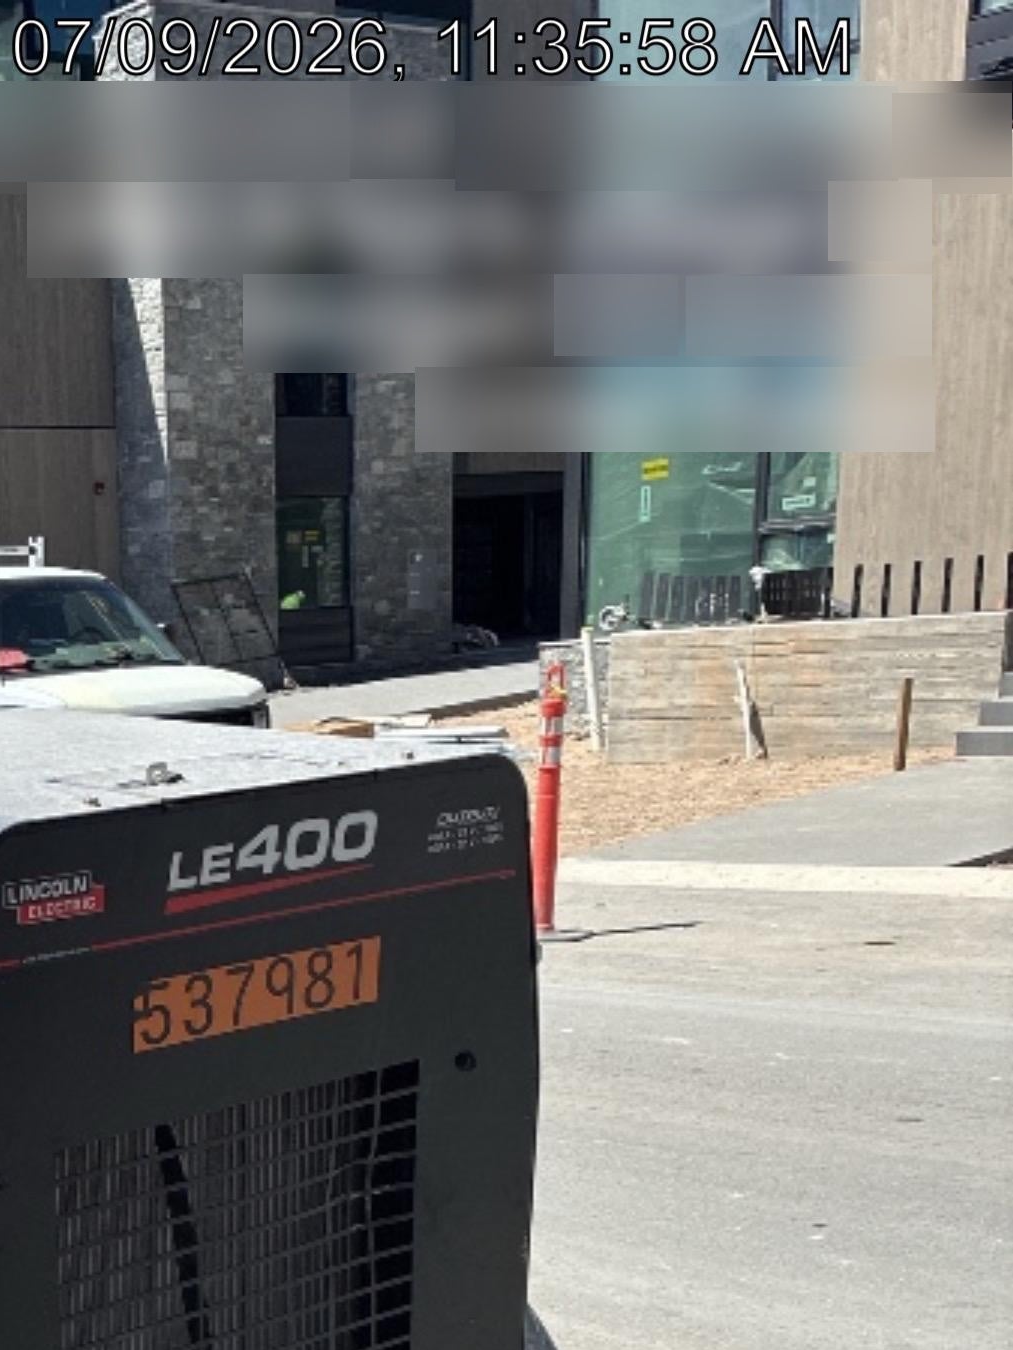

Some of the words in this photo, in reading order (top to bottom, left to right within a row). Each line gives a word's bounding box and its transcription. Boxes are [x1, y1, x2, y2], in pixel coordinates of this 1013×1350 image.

[167, 810, 378, 891] LE400
[6, 875, 87, 905] LINCOLN
[28, 896, 96, 920] ELECTRIC
[138, 943, 363, 1045] 537981
